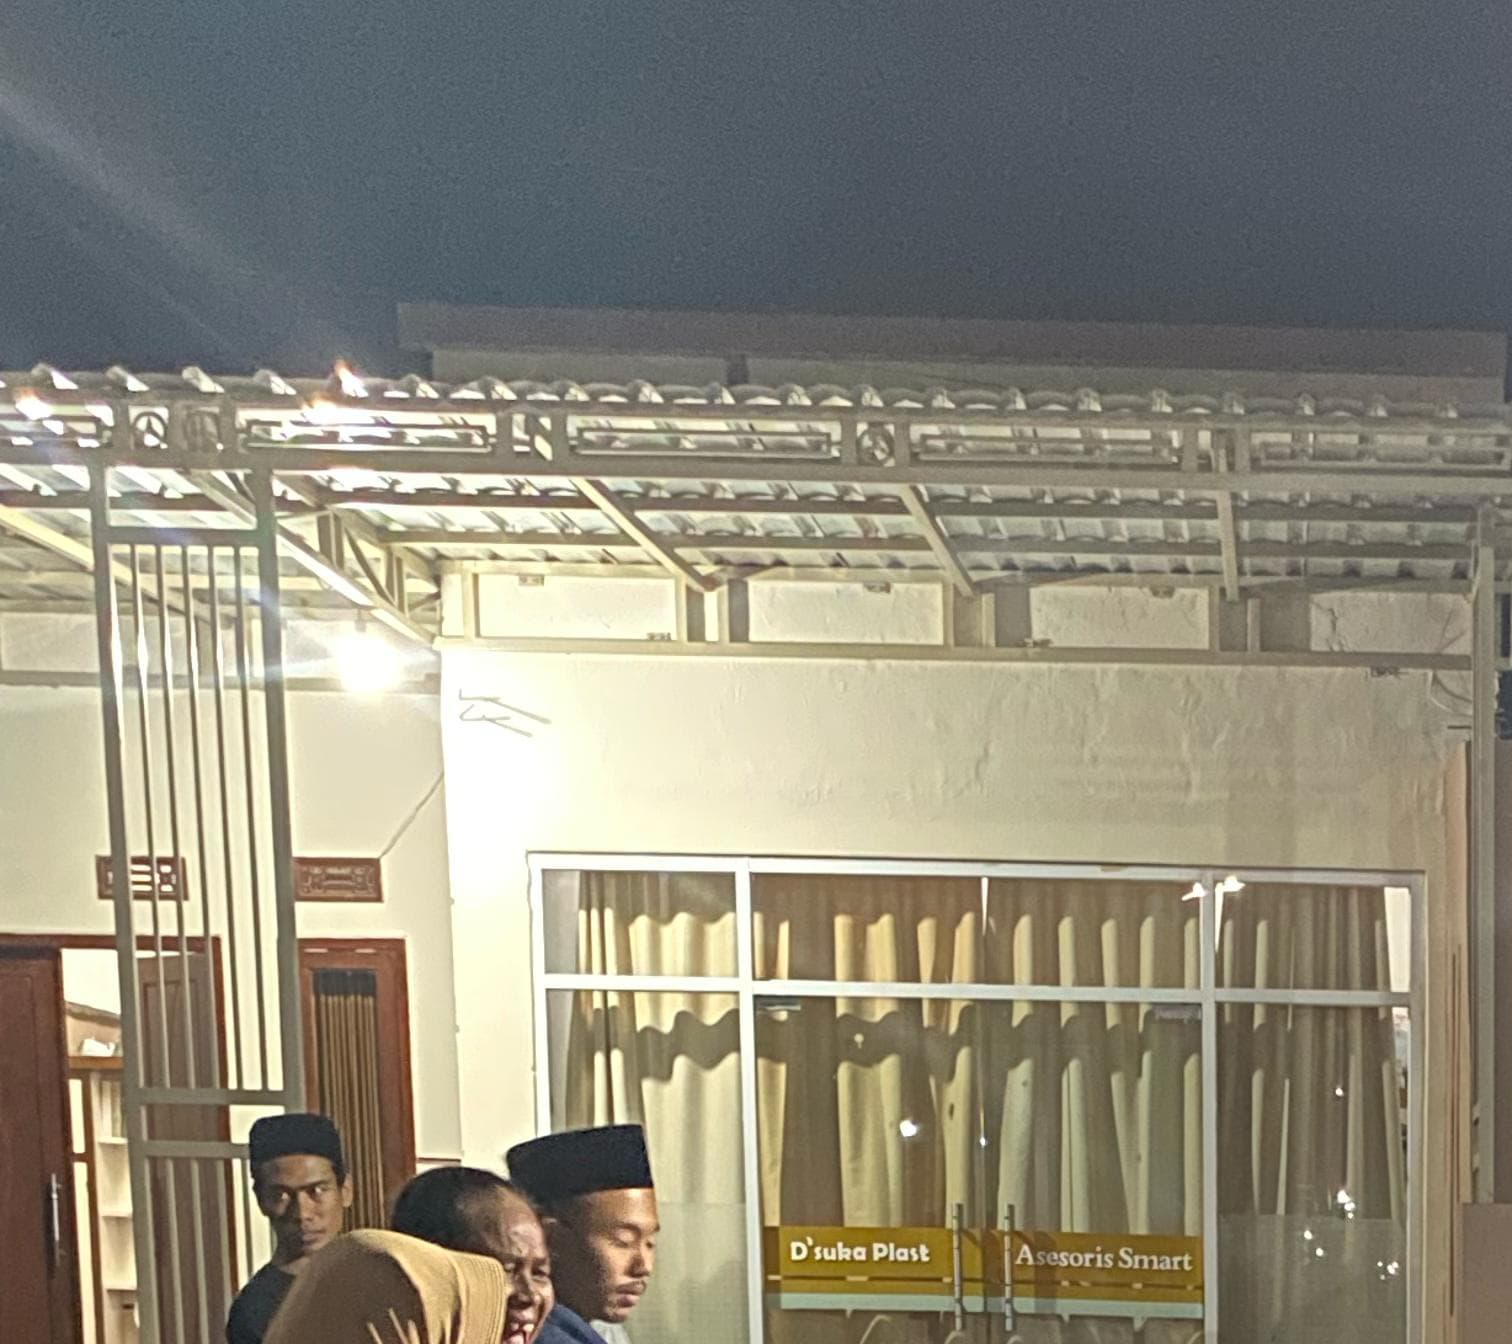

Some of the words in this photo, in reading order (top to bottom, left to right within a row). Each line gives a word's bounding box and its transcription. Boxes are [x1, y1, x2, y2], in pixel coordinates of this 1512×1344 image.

[872, 1242, 931, 1263] Plast
[1015, 1244, 1114, 1269] Asesoris
[1118, 1247, 1193, 1271] Smart
